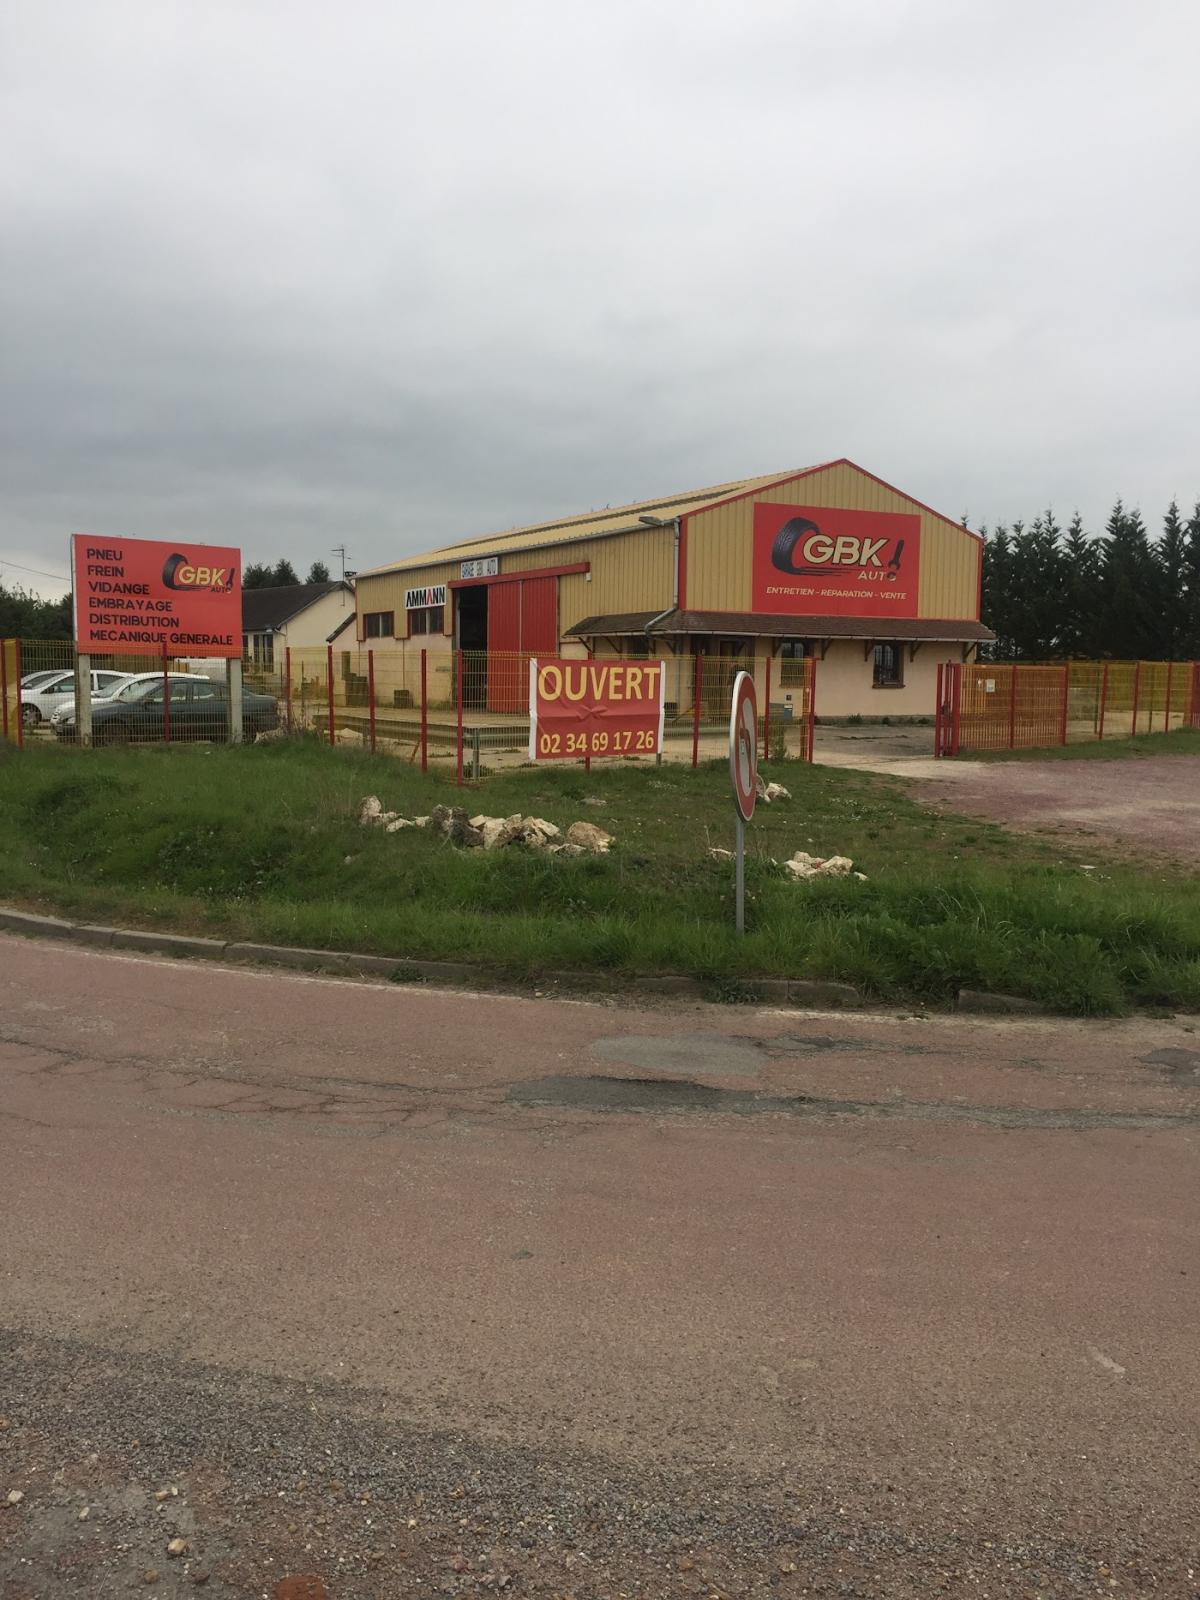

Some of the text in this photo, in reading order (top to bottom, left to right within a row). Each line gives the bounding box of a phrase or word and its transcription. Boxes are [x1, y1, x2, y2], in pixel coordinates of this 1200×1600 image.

[87, 548, 122, 561] PNEU
[803, 534, 888, 567] GBK
[87, 565, 124, 577] FREIN
[178, 565, 226, 586] GBK
[858, 570, 897, 582] AUTO
[88, 581, 150, 595] VIDANGE
[766, 586, 814, 595] ENTRETIEN
[820, 589, 873, 599] REPARATION
[880, 591, 907, 600] VENTE
[89, 597, 173, 612] EMBRAYAGE
[406, 587, 445, 608] AMMANN
[89, 613, 180, 628] DISTRIBUTION
[90, 629, 233, 646] MECANIQUE GENERALE
[538, 665, 661, 701] OUVERT
[540, 730, 654, 754] 02 34 69 17 26
